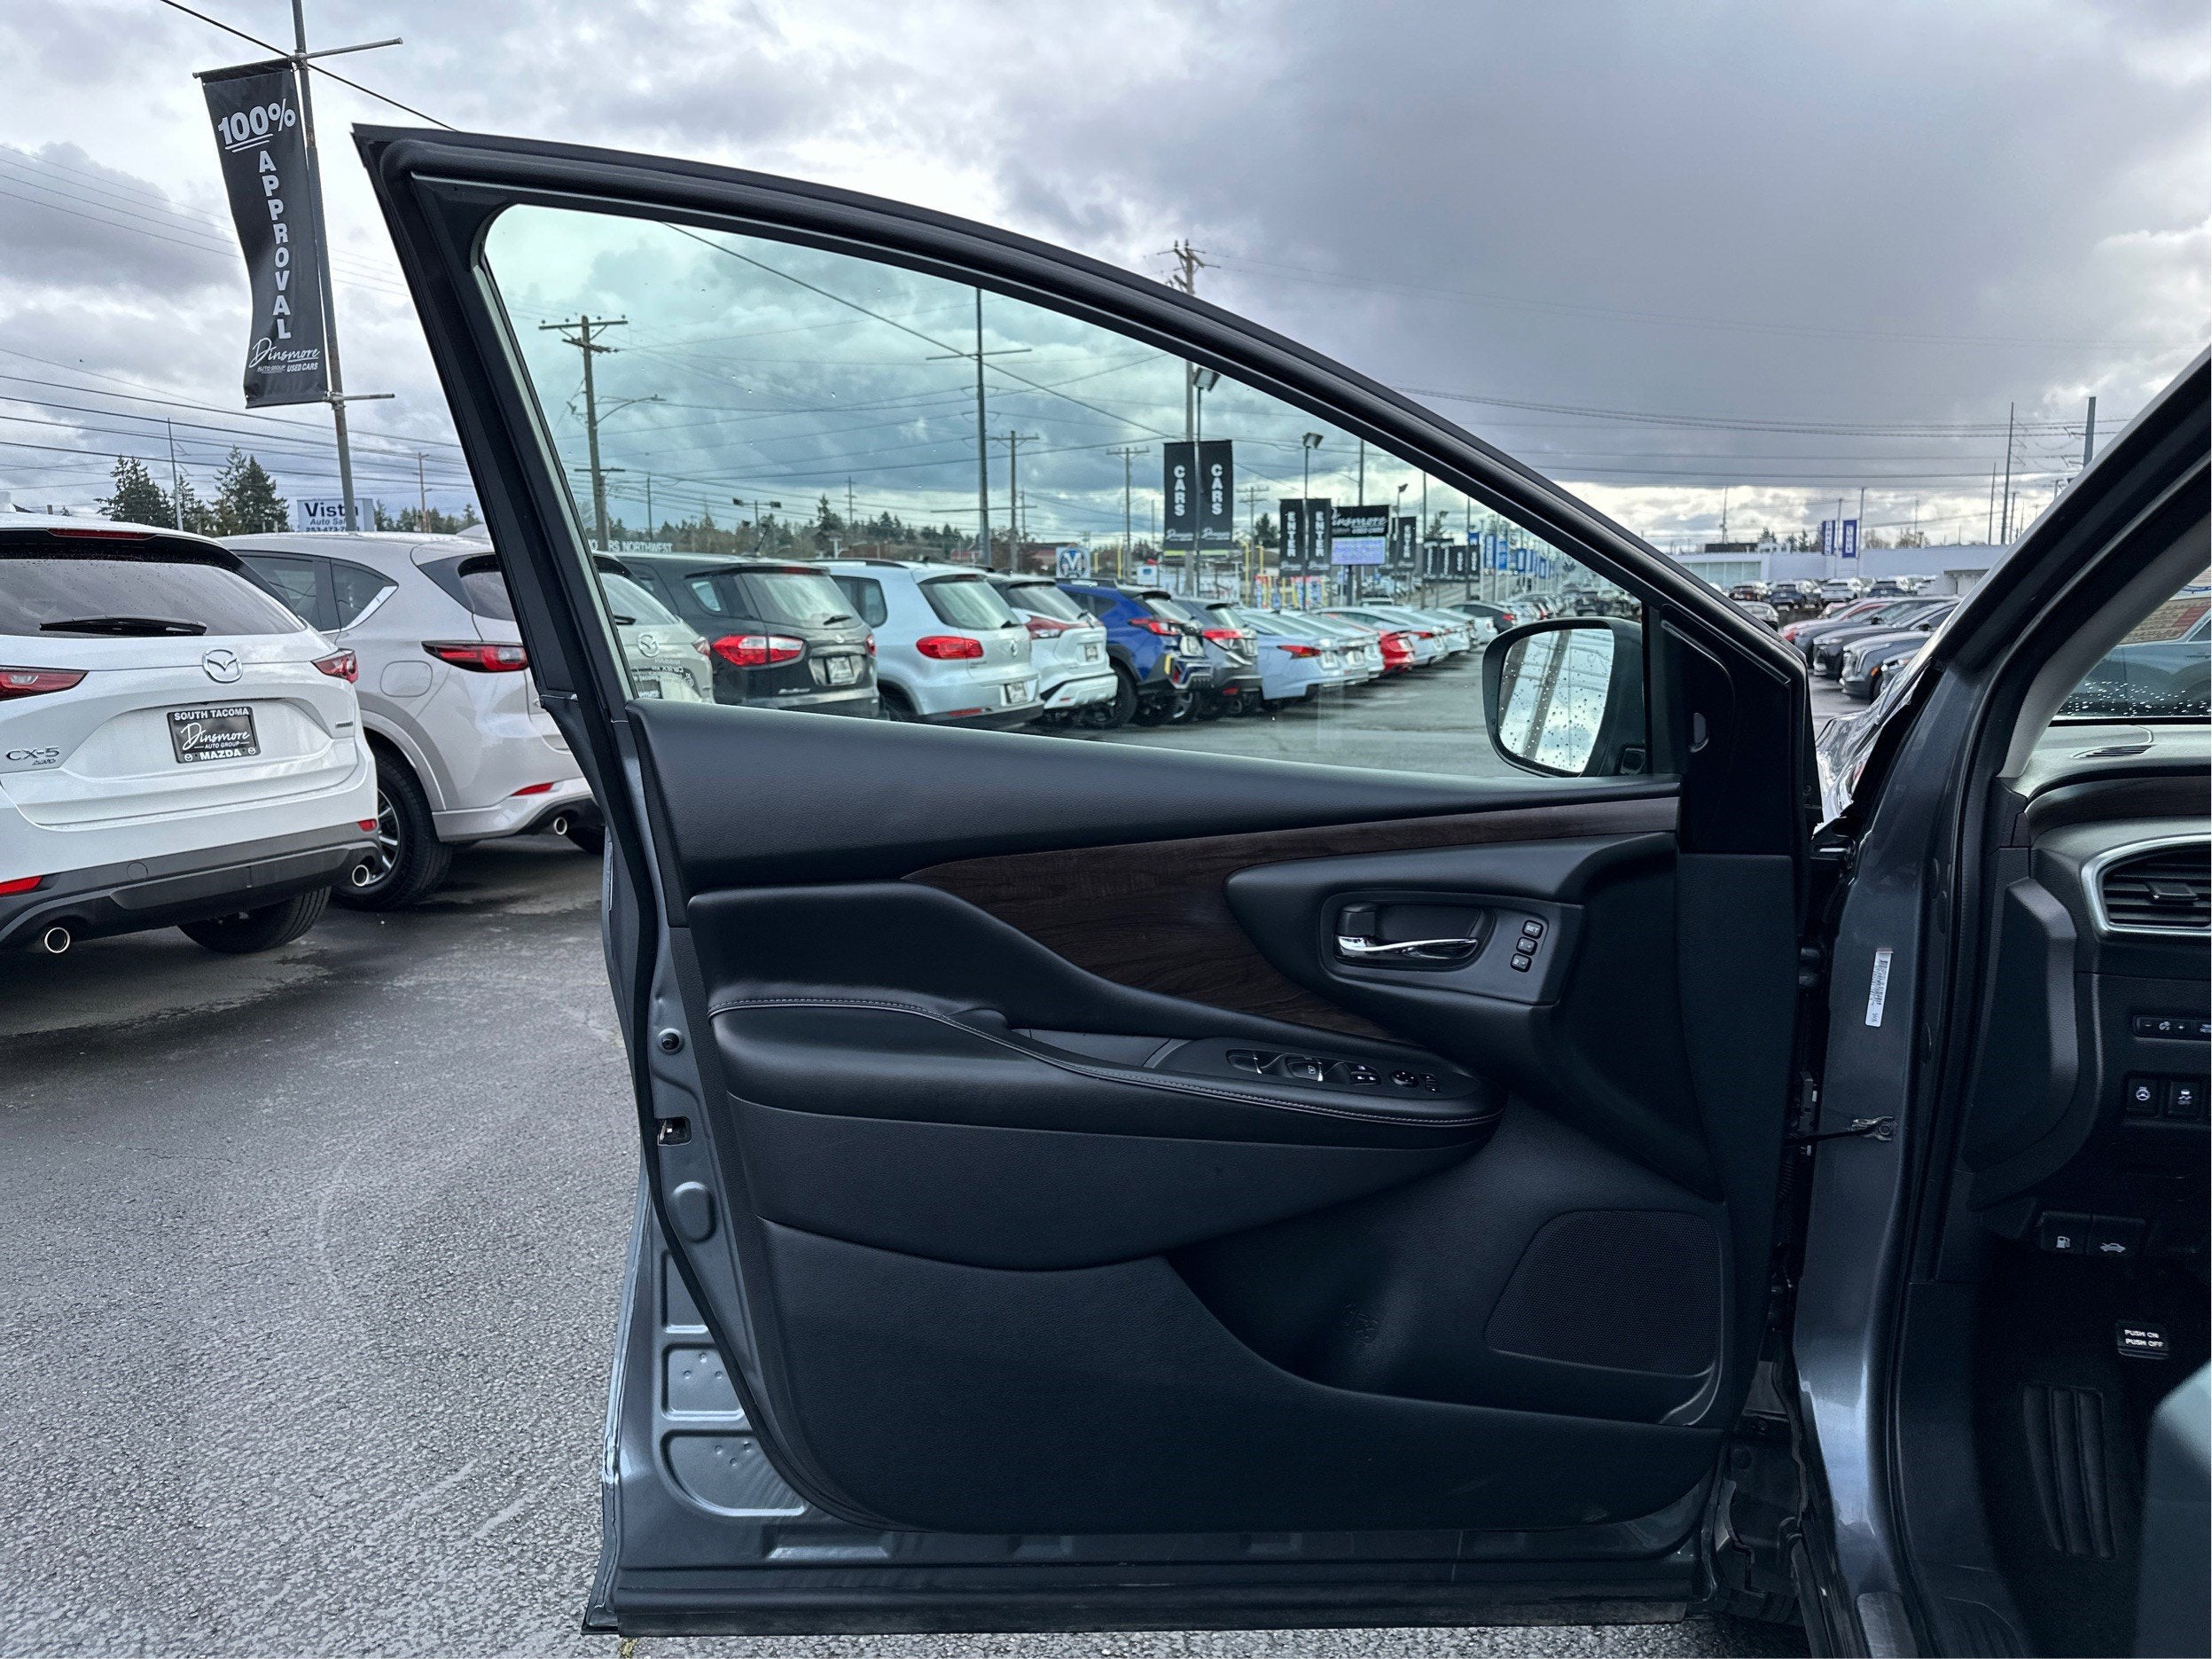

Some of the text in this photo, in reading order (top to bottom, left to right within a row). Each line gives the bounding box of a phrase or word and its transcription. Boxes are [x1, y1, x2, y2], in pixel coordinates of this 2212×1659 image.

[218, 98, 296, 145] 100%
[258, 150, 292, 340] APPROVAL
[248, 337, 320, 368] Dinsmore
[286, 364, 302, 372] USED
[302, 362, 318, 371] CARS
[1174, 465, 1186, 516] CARS
[1211, 463, 1223, 515] CARS
[622, 540, 673, 553] NORTHWEST
[1287, 511, 1296, 557] ENTER
[1315, 511, 1325, 557] ENTER
[174, 707, 249, 721] SOUTH TACOMA
[180, 722, 250, 751] Dinsmore
[5, 746, 59, 761] CX-5
[199, 749, 241, 760] MAZDA
